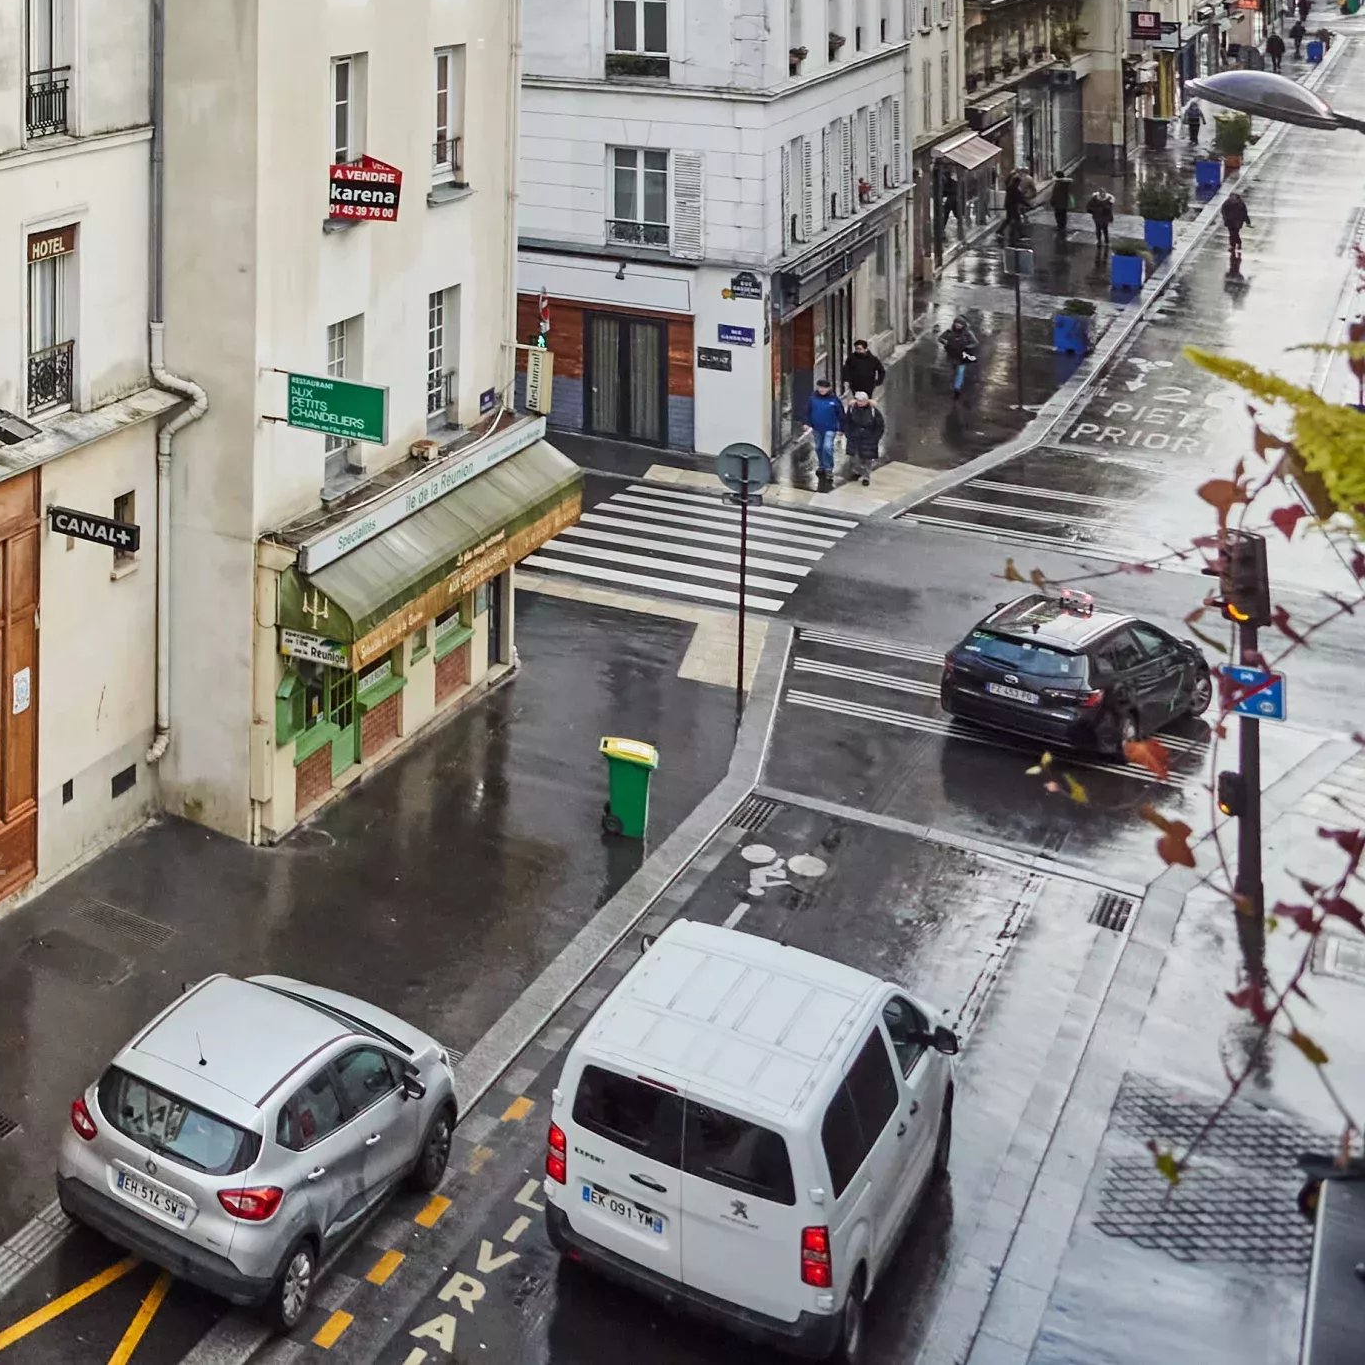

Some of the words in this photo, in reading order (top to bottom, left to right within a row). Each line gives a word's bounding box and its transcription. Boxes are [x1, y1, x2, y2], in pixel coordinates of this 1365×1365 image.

[334, 169, 344, 179] A
[346, 170, 395, 183] VENDRE
[331, 183, 394, 204] karena
[329, 204, 340, 213] 01
[342, 205, 354, 215] 45
[355, 206, 367, 216] 39
[369, 207, 381, 217] 76
[382, 208, 393, 218] 00
[32, 236, 66, 259] HOTEL
[291, 377, 334, 390] RESTAURANT
[529, 350, 541, 409] Restaurant
[291, 386, 313, 398] AUX
[291, 396, 328, 411] PETITS
[291, 406, 365, 429] CHANDELIERS
[419, 486, 428, 503] de
[441, 461, 475, 491] Réunion
[56, 514, 131, 545] CANAL+
[574, 1146, 606, 1165] EXPERT
